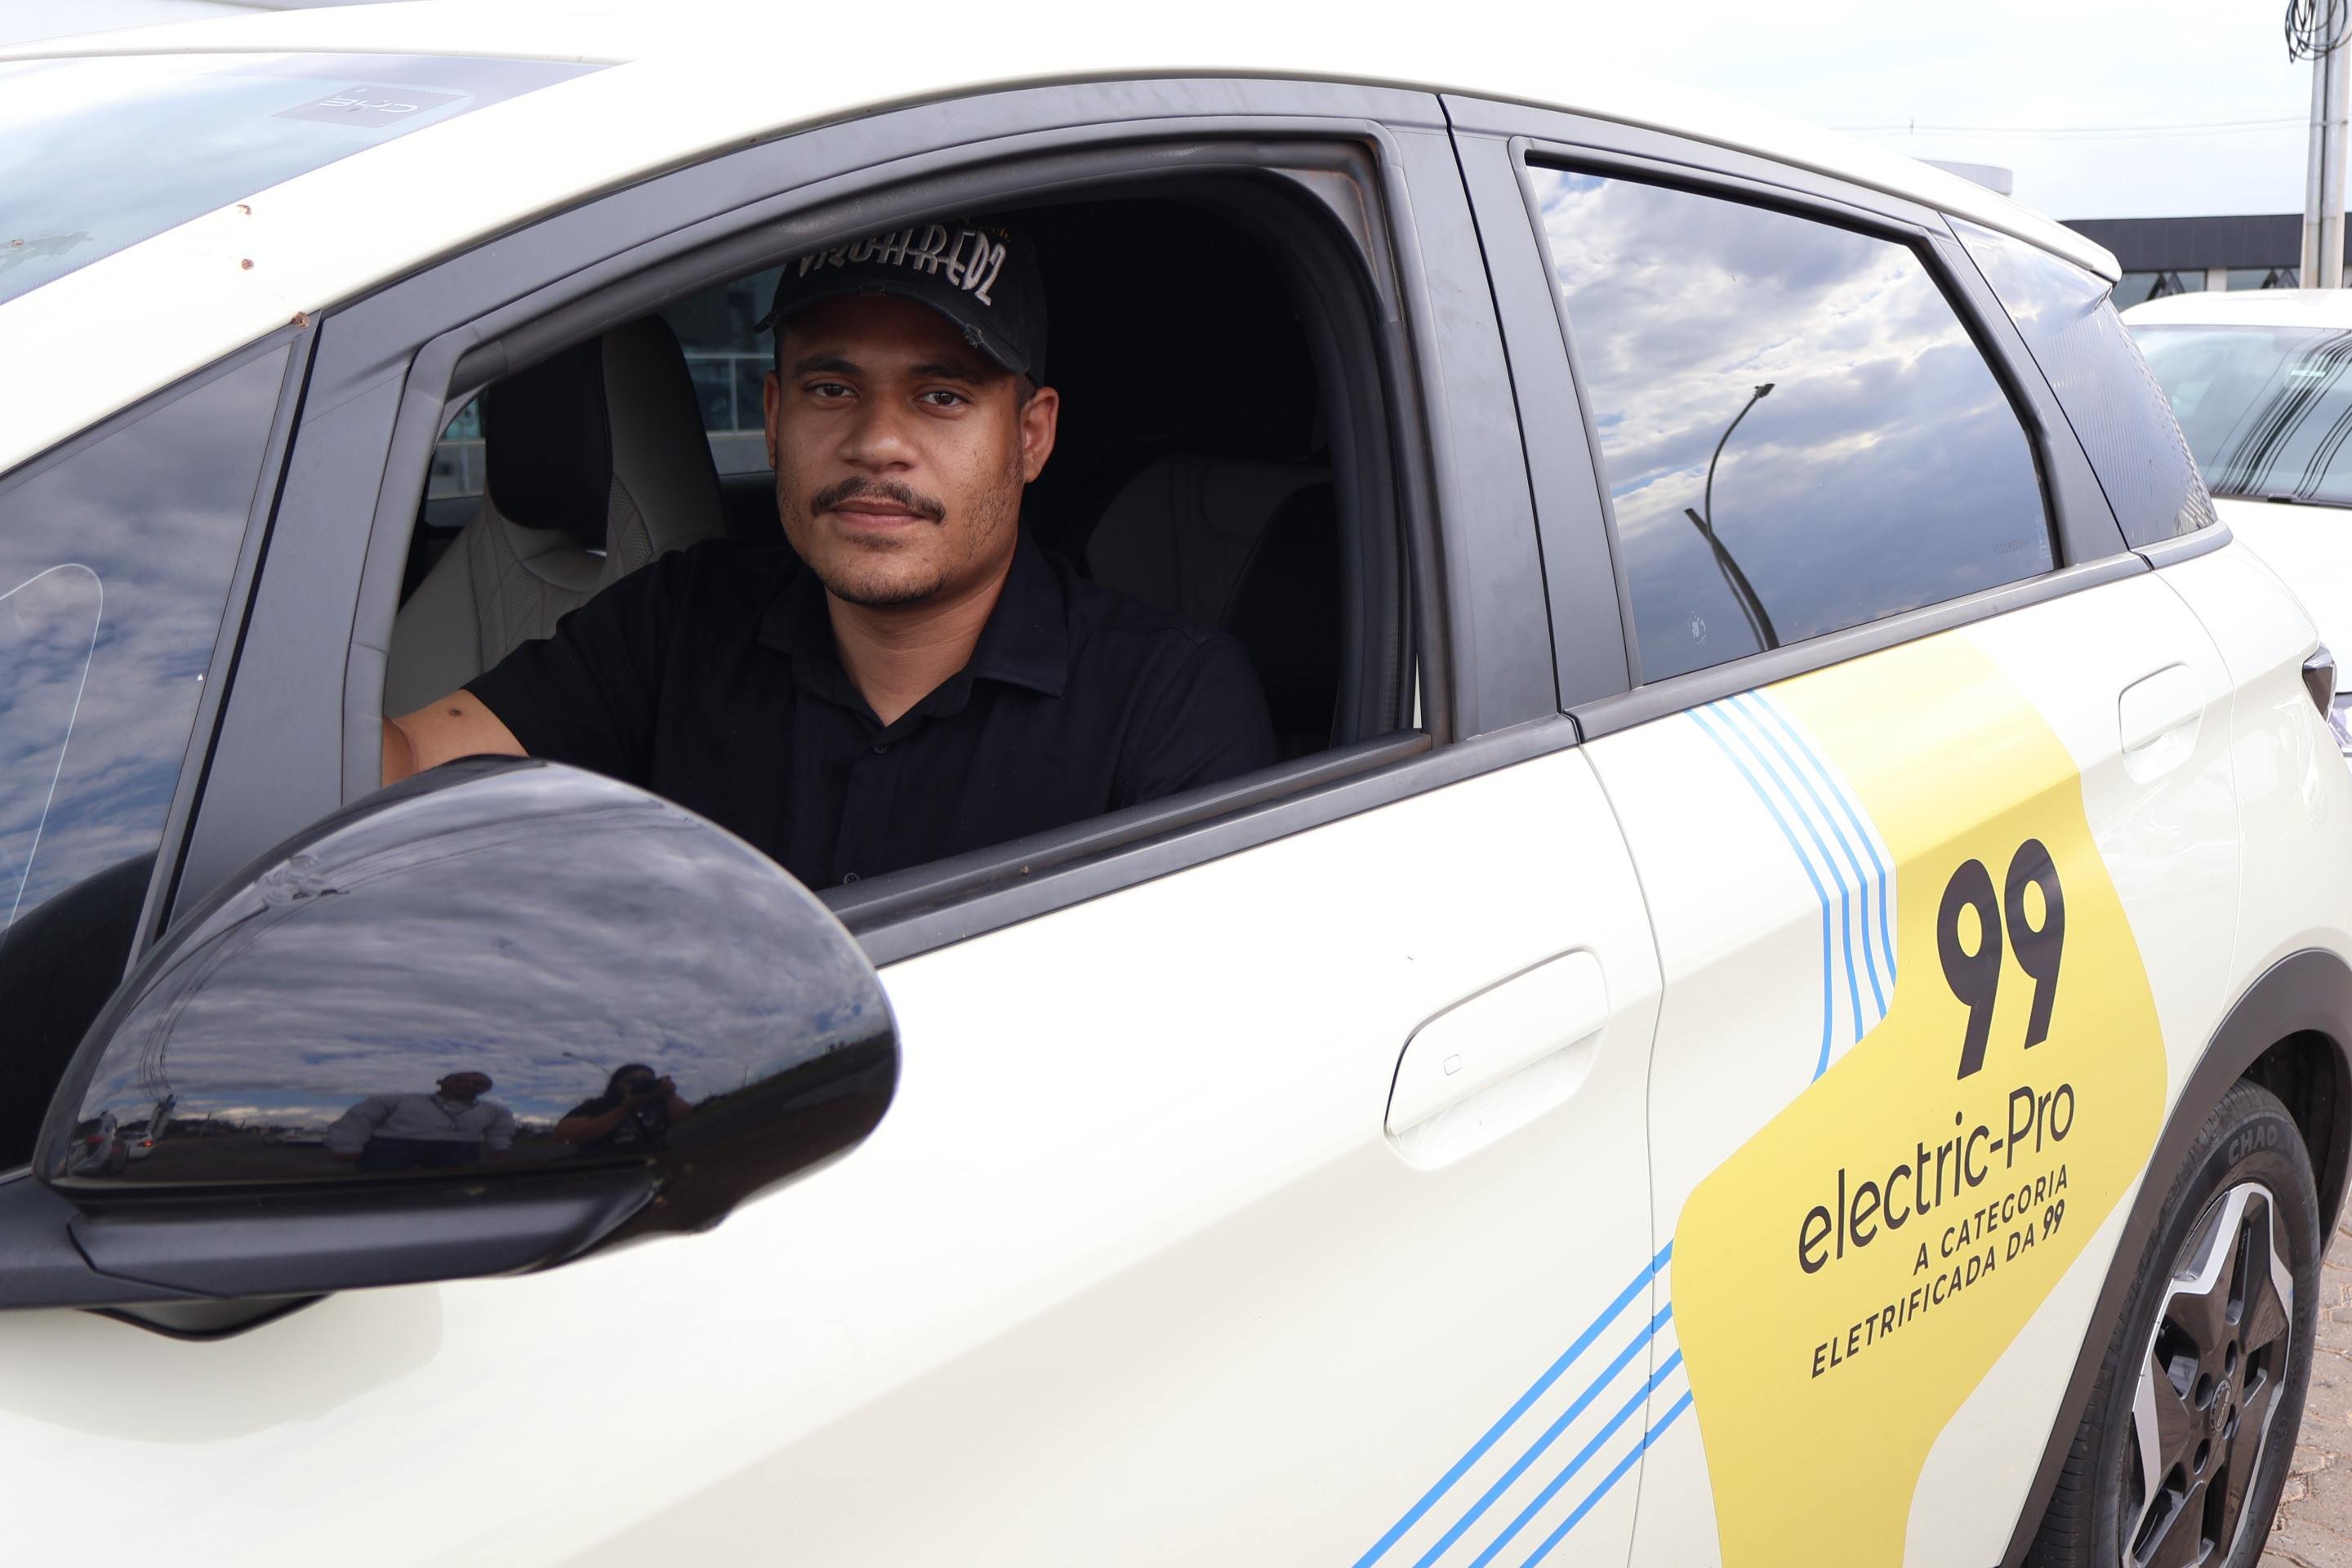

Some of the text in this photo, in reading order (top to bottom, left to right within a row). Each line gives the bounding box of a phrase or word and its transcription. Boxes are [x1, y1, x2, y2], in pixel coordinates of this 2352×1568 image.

[1936, 838, 2066, 1080] 99
[1798, 1082, 2075, 1275] electric-Pro
[1912, 1164, 2068, 1276] A CATEGORIA
[1811, 1199, 2065, 1379] ELETRIFICADA DA 99
